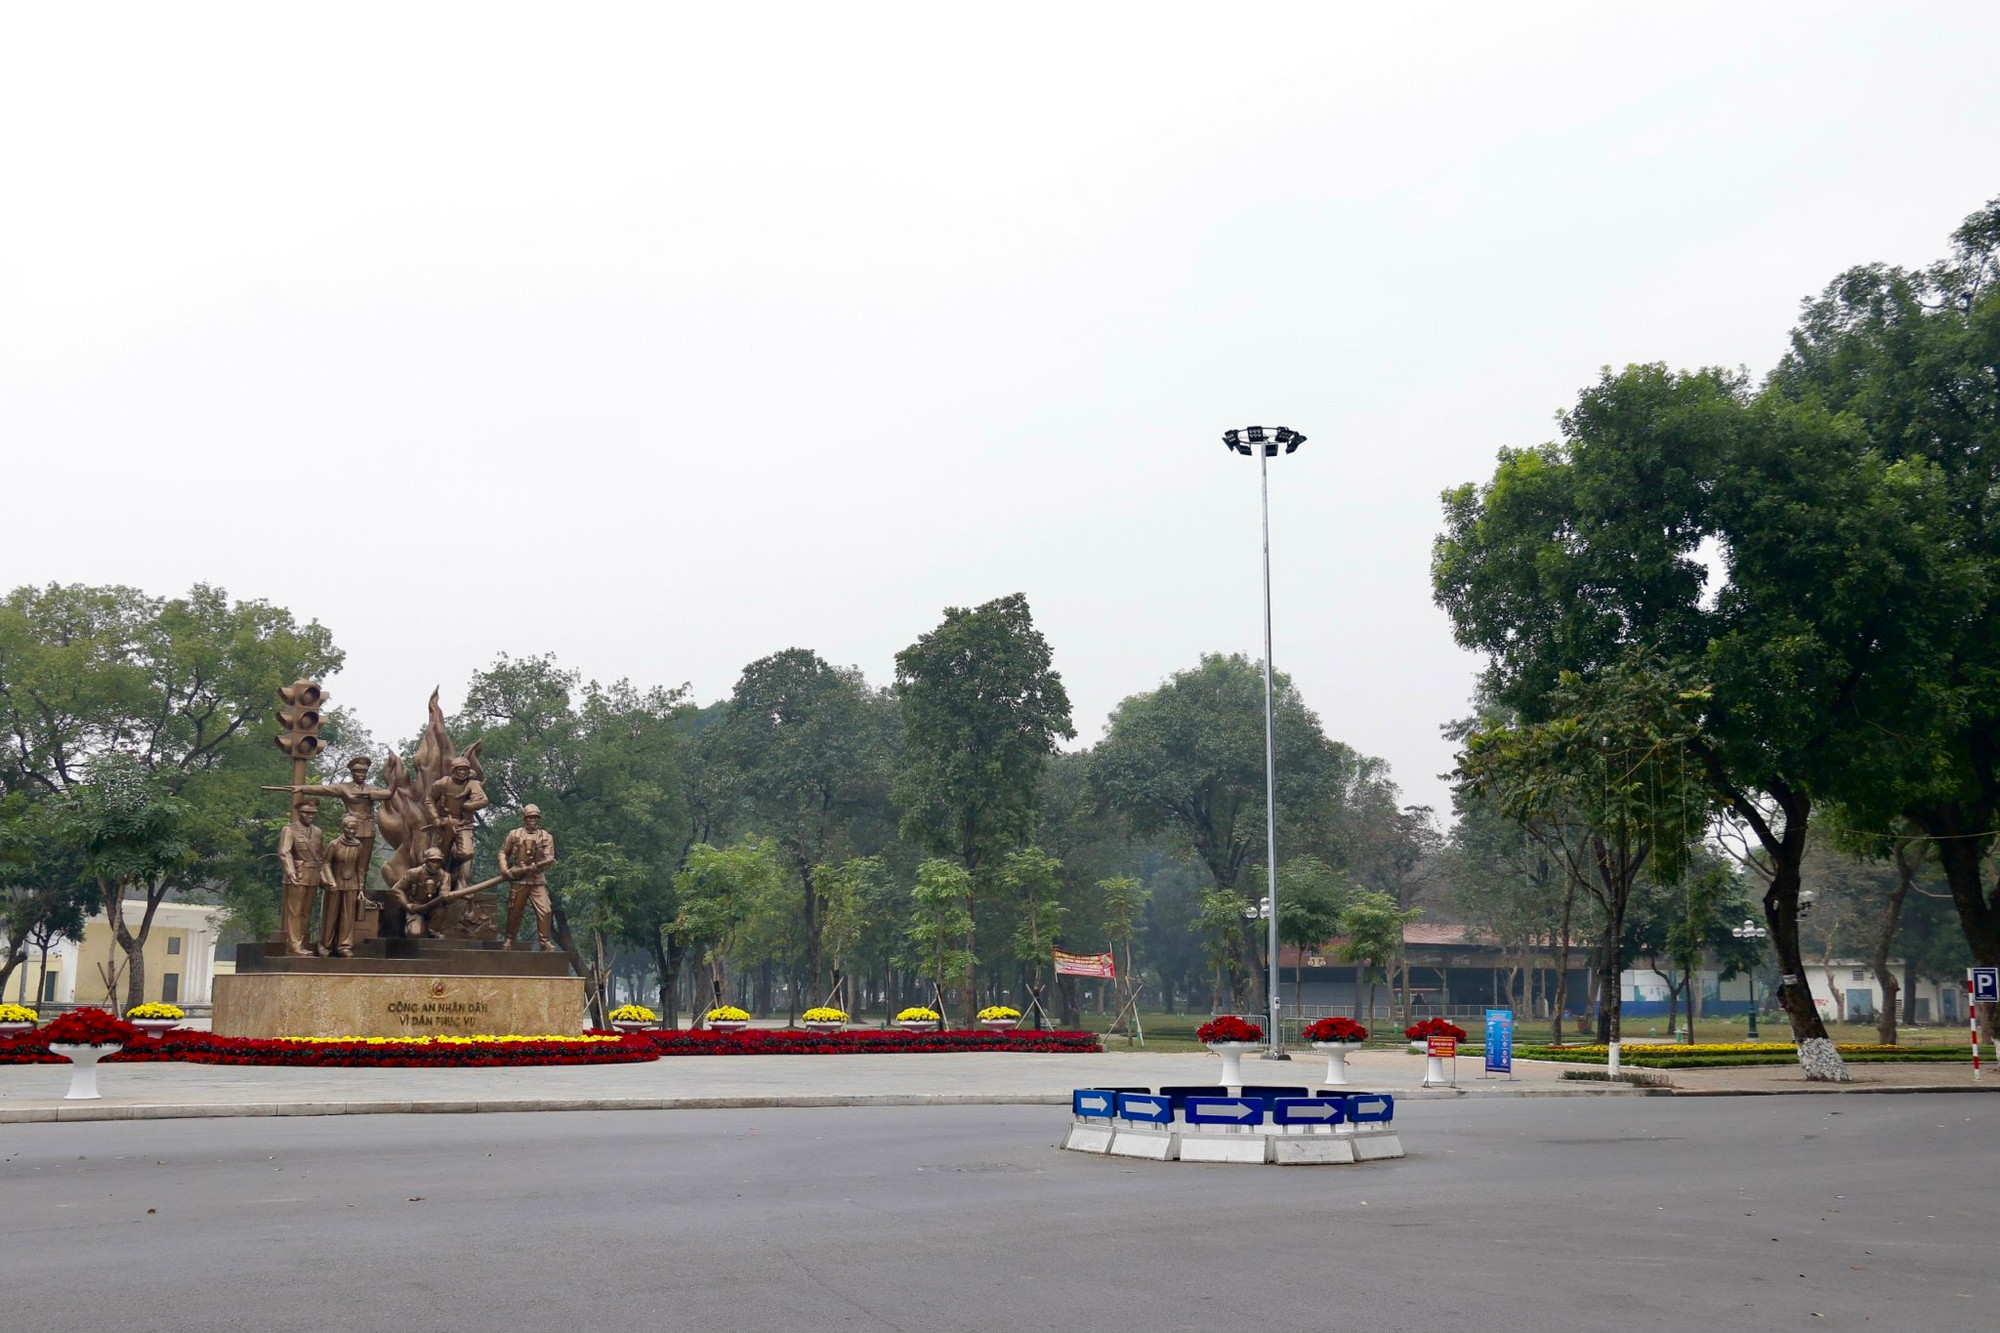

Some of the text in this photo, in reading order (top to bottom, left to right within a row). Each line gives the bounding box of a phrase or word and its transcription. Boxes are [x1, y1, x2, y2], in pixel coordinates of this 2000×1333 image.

[1977, 974, 1992, 993] P
[388, 1001, 488, 1013] CÔNG AN NHÂN DÂN
[399, 1014, 409, 1026] VÌ
[411, 1015, 433, 1026] DÂN
